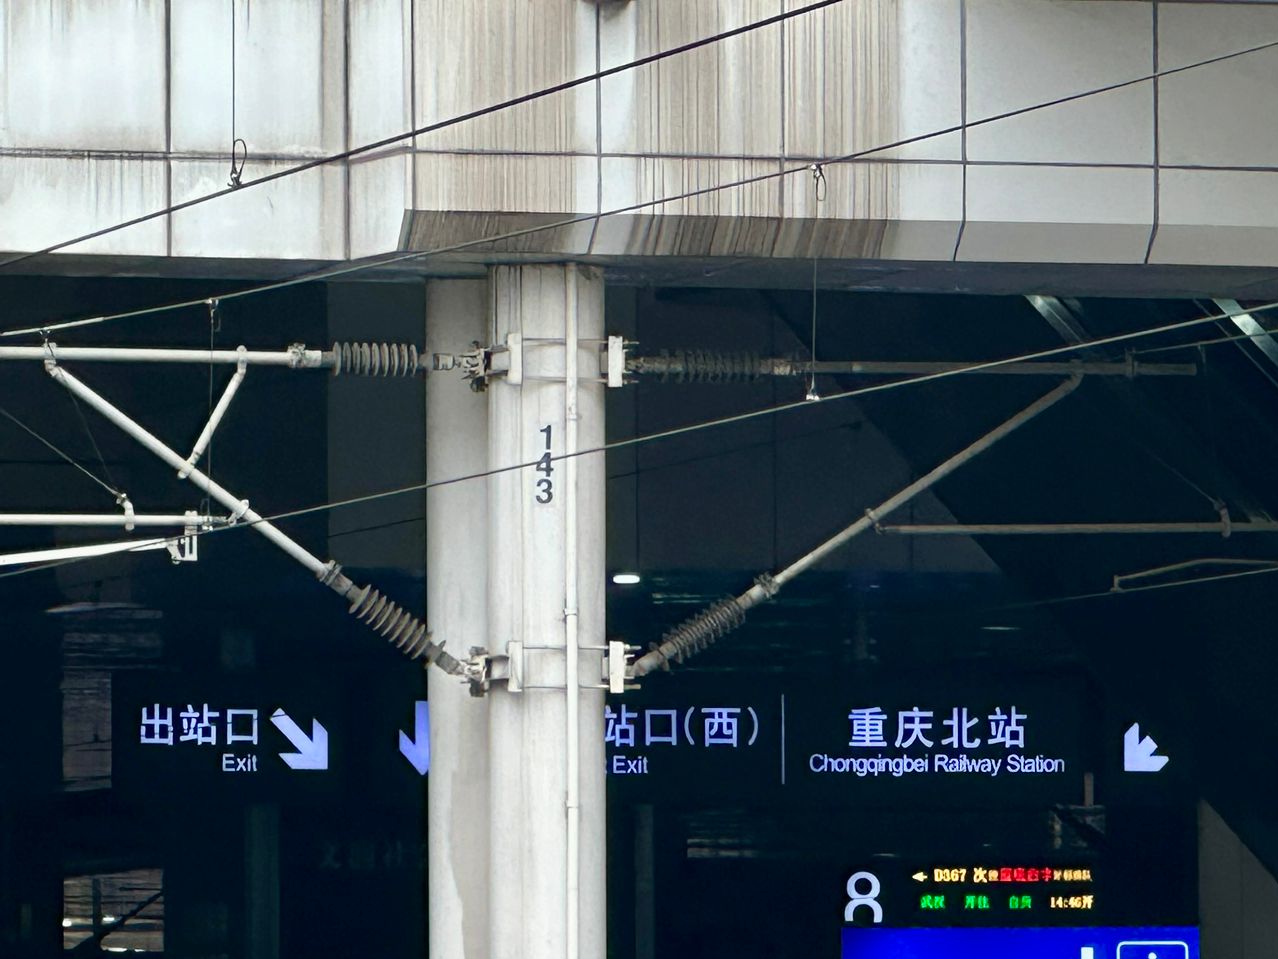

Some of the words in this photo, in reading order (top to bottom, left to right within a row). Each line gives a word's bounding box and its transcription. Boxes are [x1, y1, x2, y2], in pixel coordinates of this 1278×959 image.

[535, 425, 554, 504] 143
[140, 703, 258, 746] 出站口
[848, 705, 1028, 748] 重庆北站
[222, 753, 258, 772] Exit
[612, 755, 648, 774] Exit
[809, 753, 928, 776] Chongqingbei
[934, 753, 1001, 776] Railway
[1006, 754, 1065, 774] Station
[844, 871, 883, 923] 8
